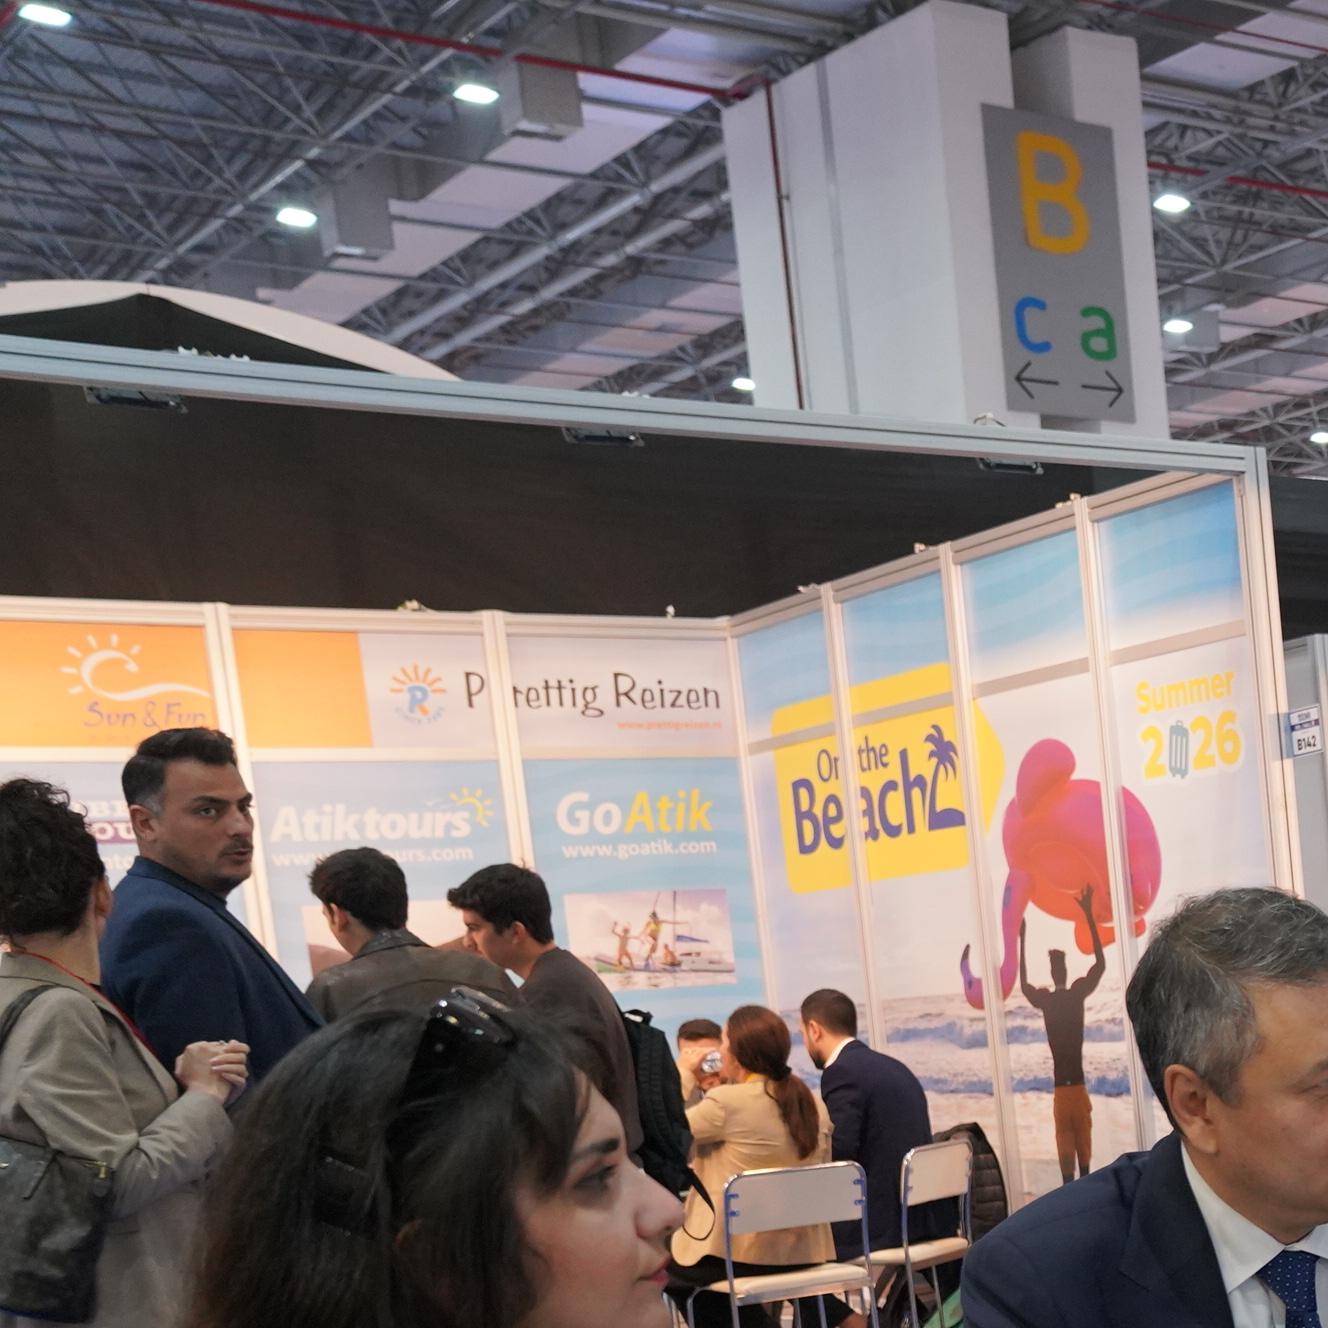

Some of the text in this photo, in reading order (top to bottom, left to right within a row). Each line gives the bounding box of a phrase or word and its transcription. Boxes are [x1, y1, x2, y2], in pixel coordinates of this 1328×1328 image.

[1016, 130, 1090, 255] B
[1080, 305, 1118, 362] a
[84, 700, 208, 729] Sun & Fun
[463, 671, 604, 718] Prettig
[613, 672, 721, 709] Reizen
[1135, 671, 1236, 715] Summer
[858, 735, 890, 773] the
[1297, 735, 1317, 751] B142
[269, 801, 473, 842] Atiktours
[556, 788, 714, 835] GoAtik
[791, 747, 928, 855] Beach
[561, 839, 718, 861] www.goatik.com
